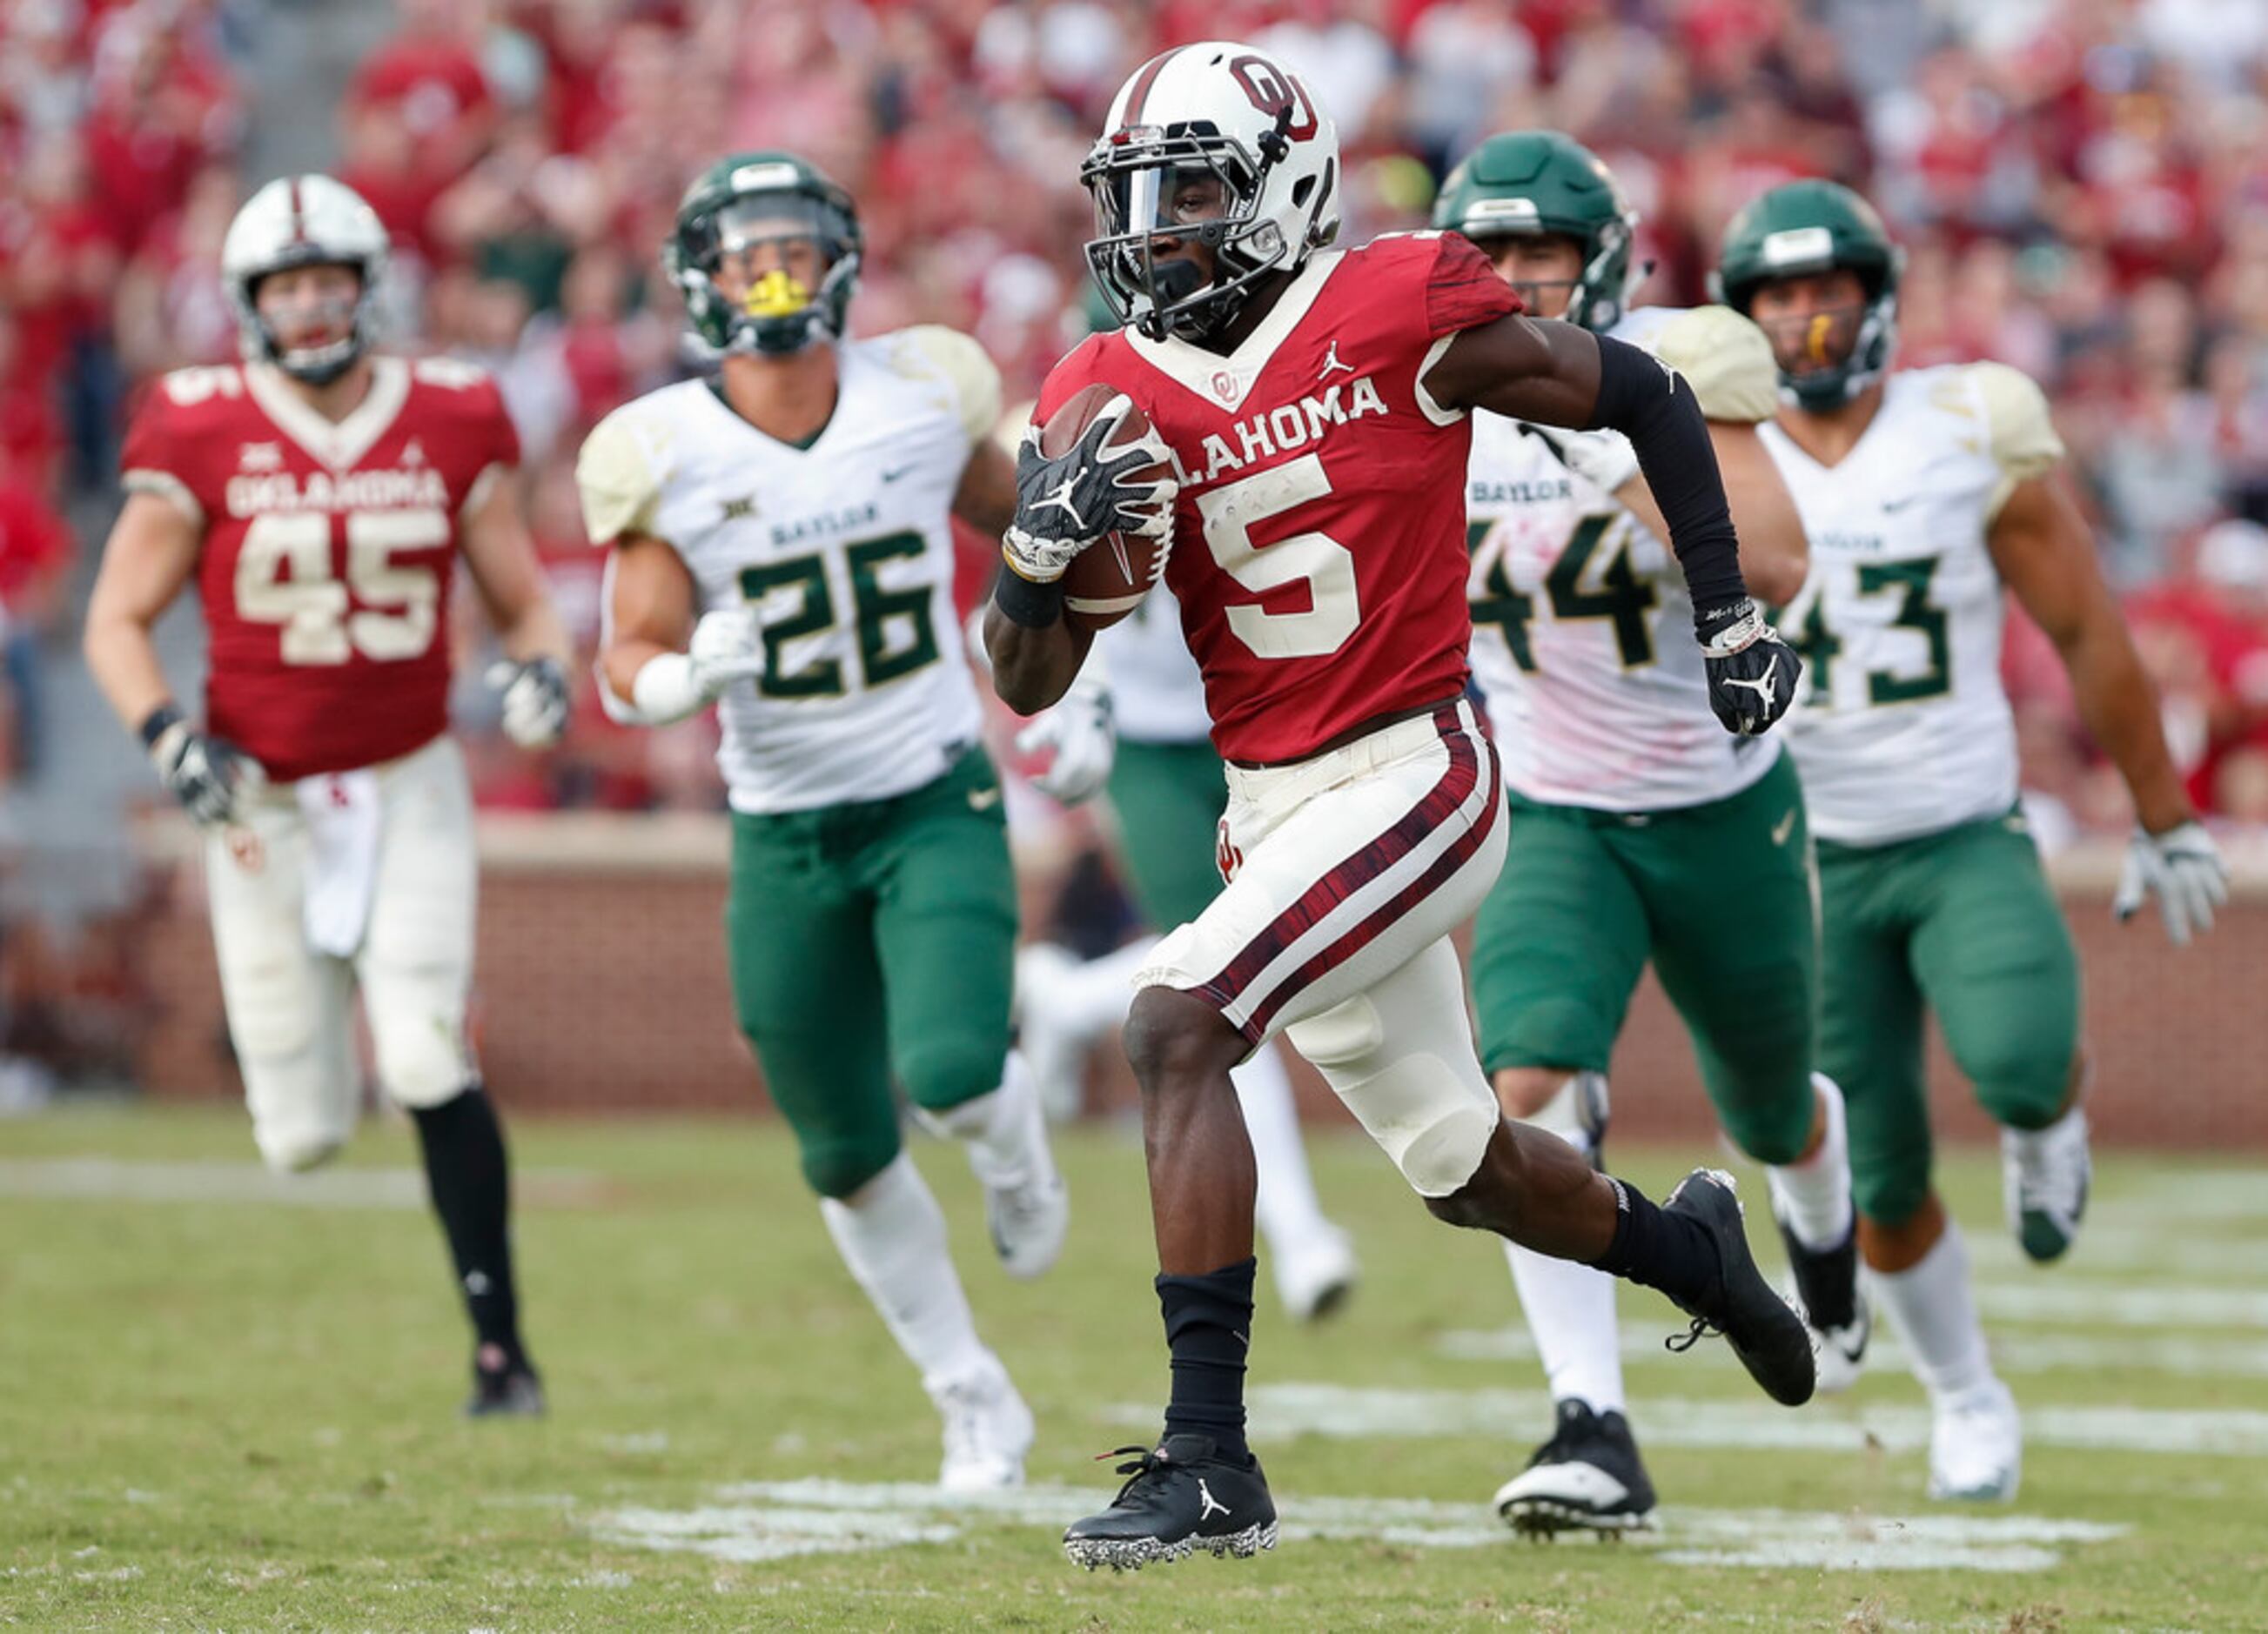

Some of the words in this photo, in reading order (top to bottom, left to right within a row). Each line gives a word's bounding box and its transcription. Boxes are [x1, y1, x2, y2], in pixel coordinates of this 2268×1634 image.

[1229, 55, 1319, 143] OU
[1169, 376, 1389, 488] LAHOMA
[1211, 372, 1238, 403] OU
[1472, 480, 1572, 503] BAYLOR
[233, 510, 451, 666] 45
[1196, 452, 1361, 660] 5
[738, 526, 943, 700] 26
